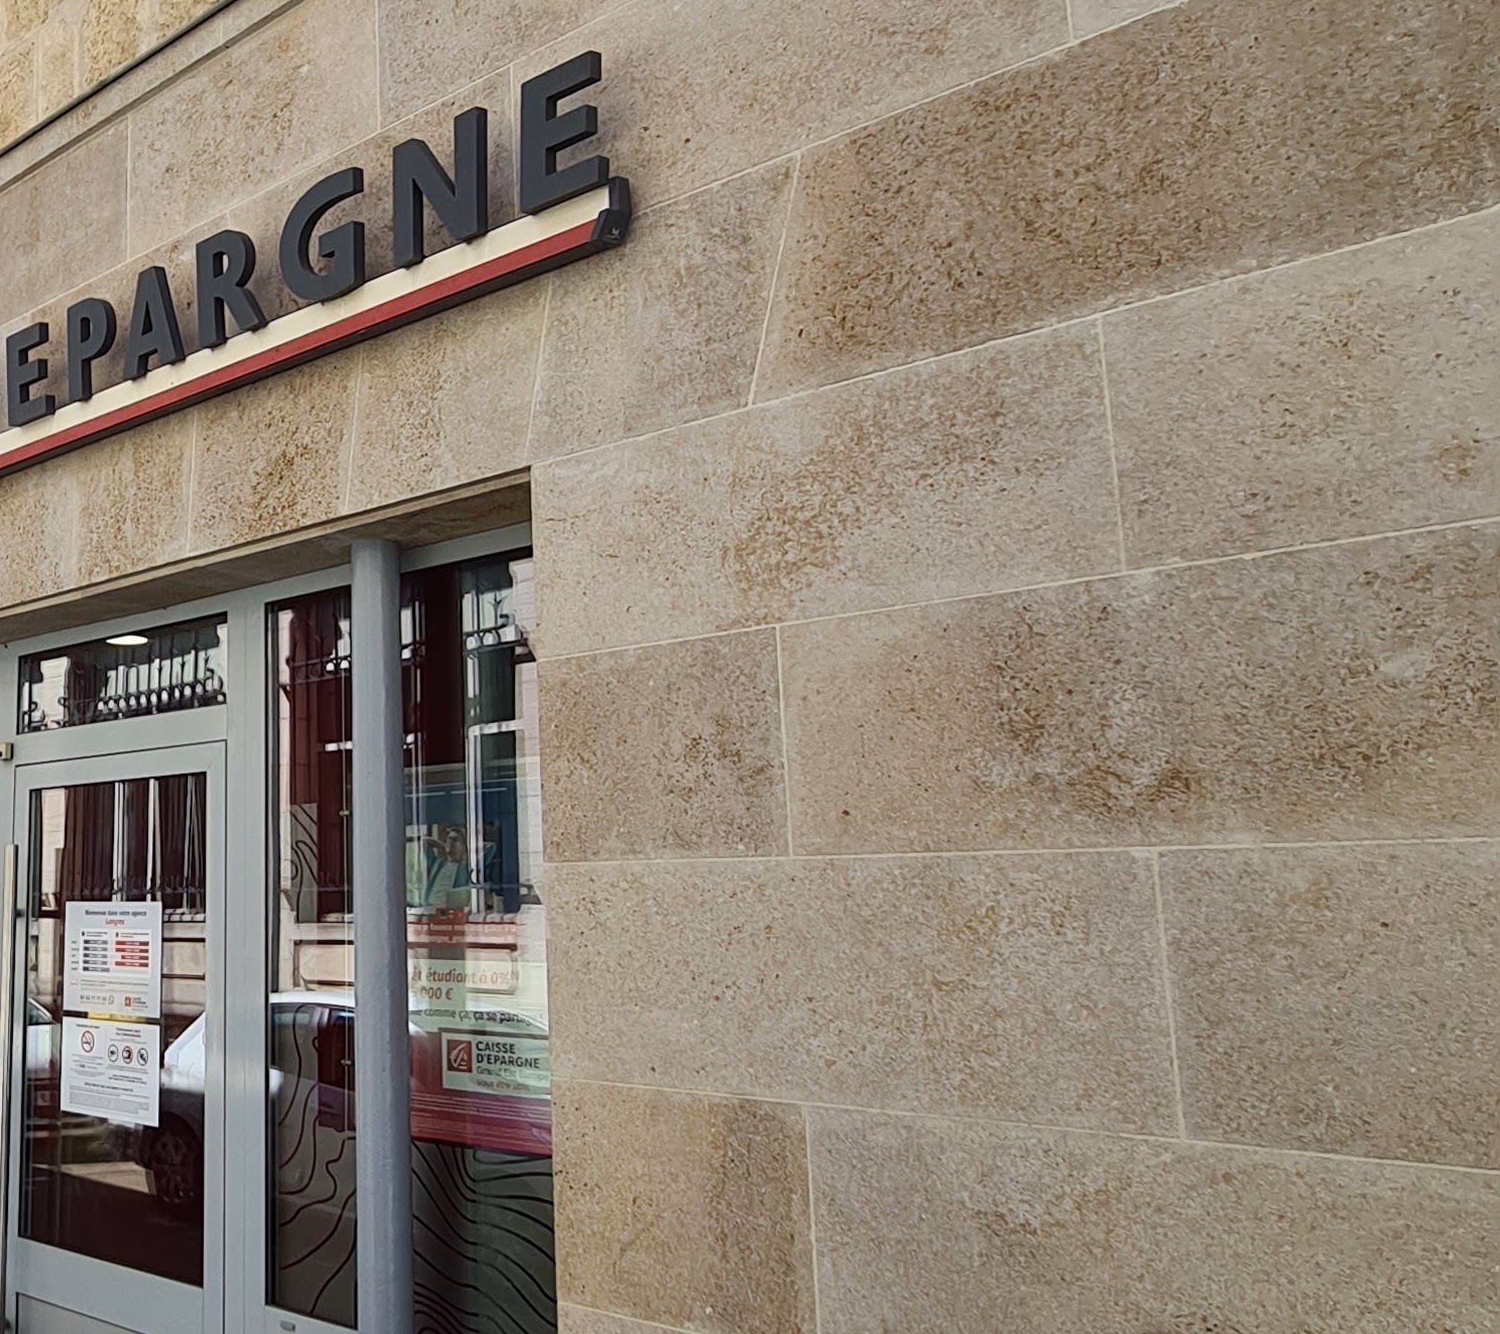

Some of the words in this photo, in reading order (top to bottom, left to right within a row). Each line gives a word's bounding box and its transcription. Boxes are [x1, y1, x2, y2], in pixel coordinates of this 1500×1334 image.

[426, 967, 477, 985] étudiant
[476, 1041, 516, 1055] CAISSE
[476, 1054, 541, 1069] D'EPARGNE
